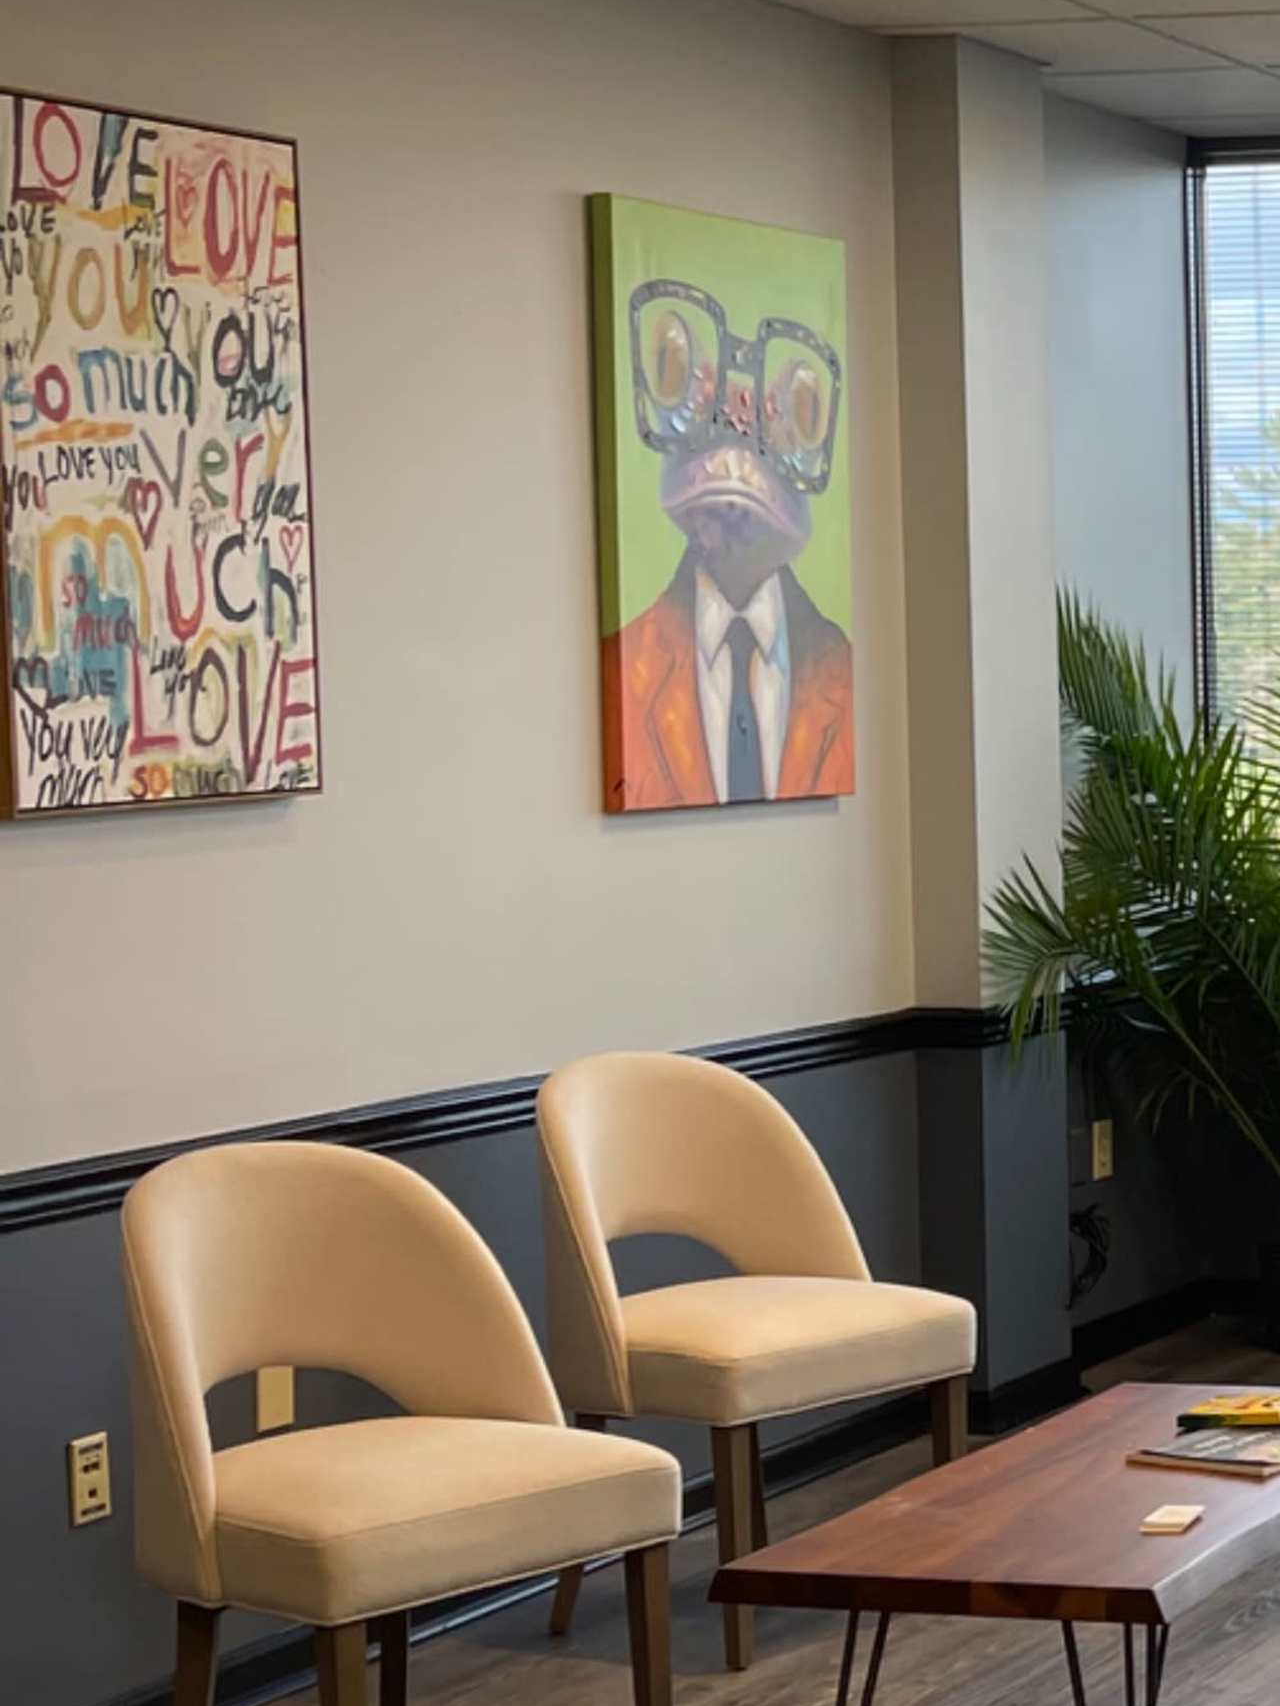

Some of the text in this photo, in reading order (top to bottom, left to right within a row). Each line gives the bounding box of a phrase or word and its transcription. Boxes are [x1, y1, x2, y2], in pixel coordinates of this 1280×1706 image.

[11, 95, 159, 210] LOVE
[164, 156, 297, 286] LOVE
[39, 446, 96, 484] LOVE
[129, 641, 318, 785] LOVE
